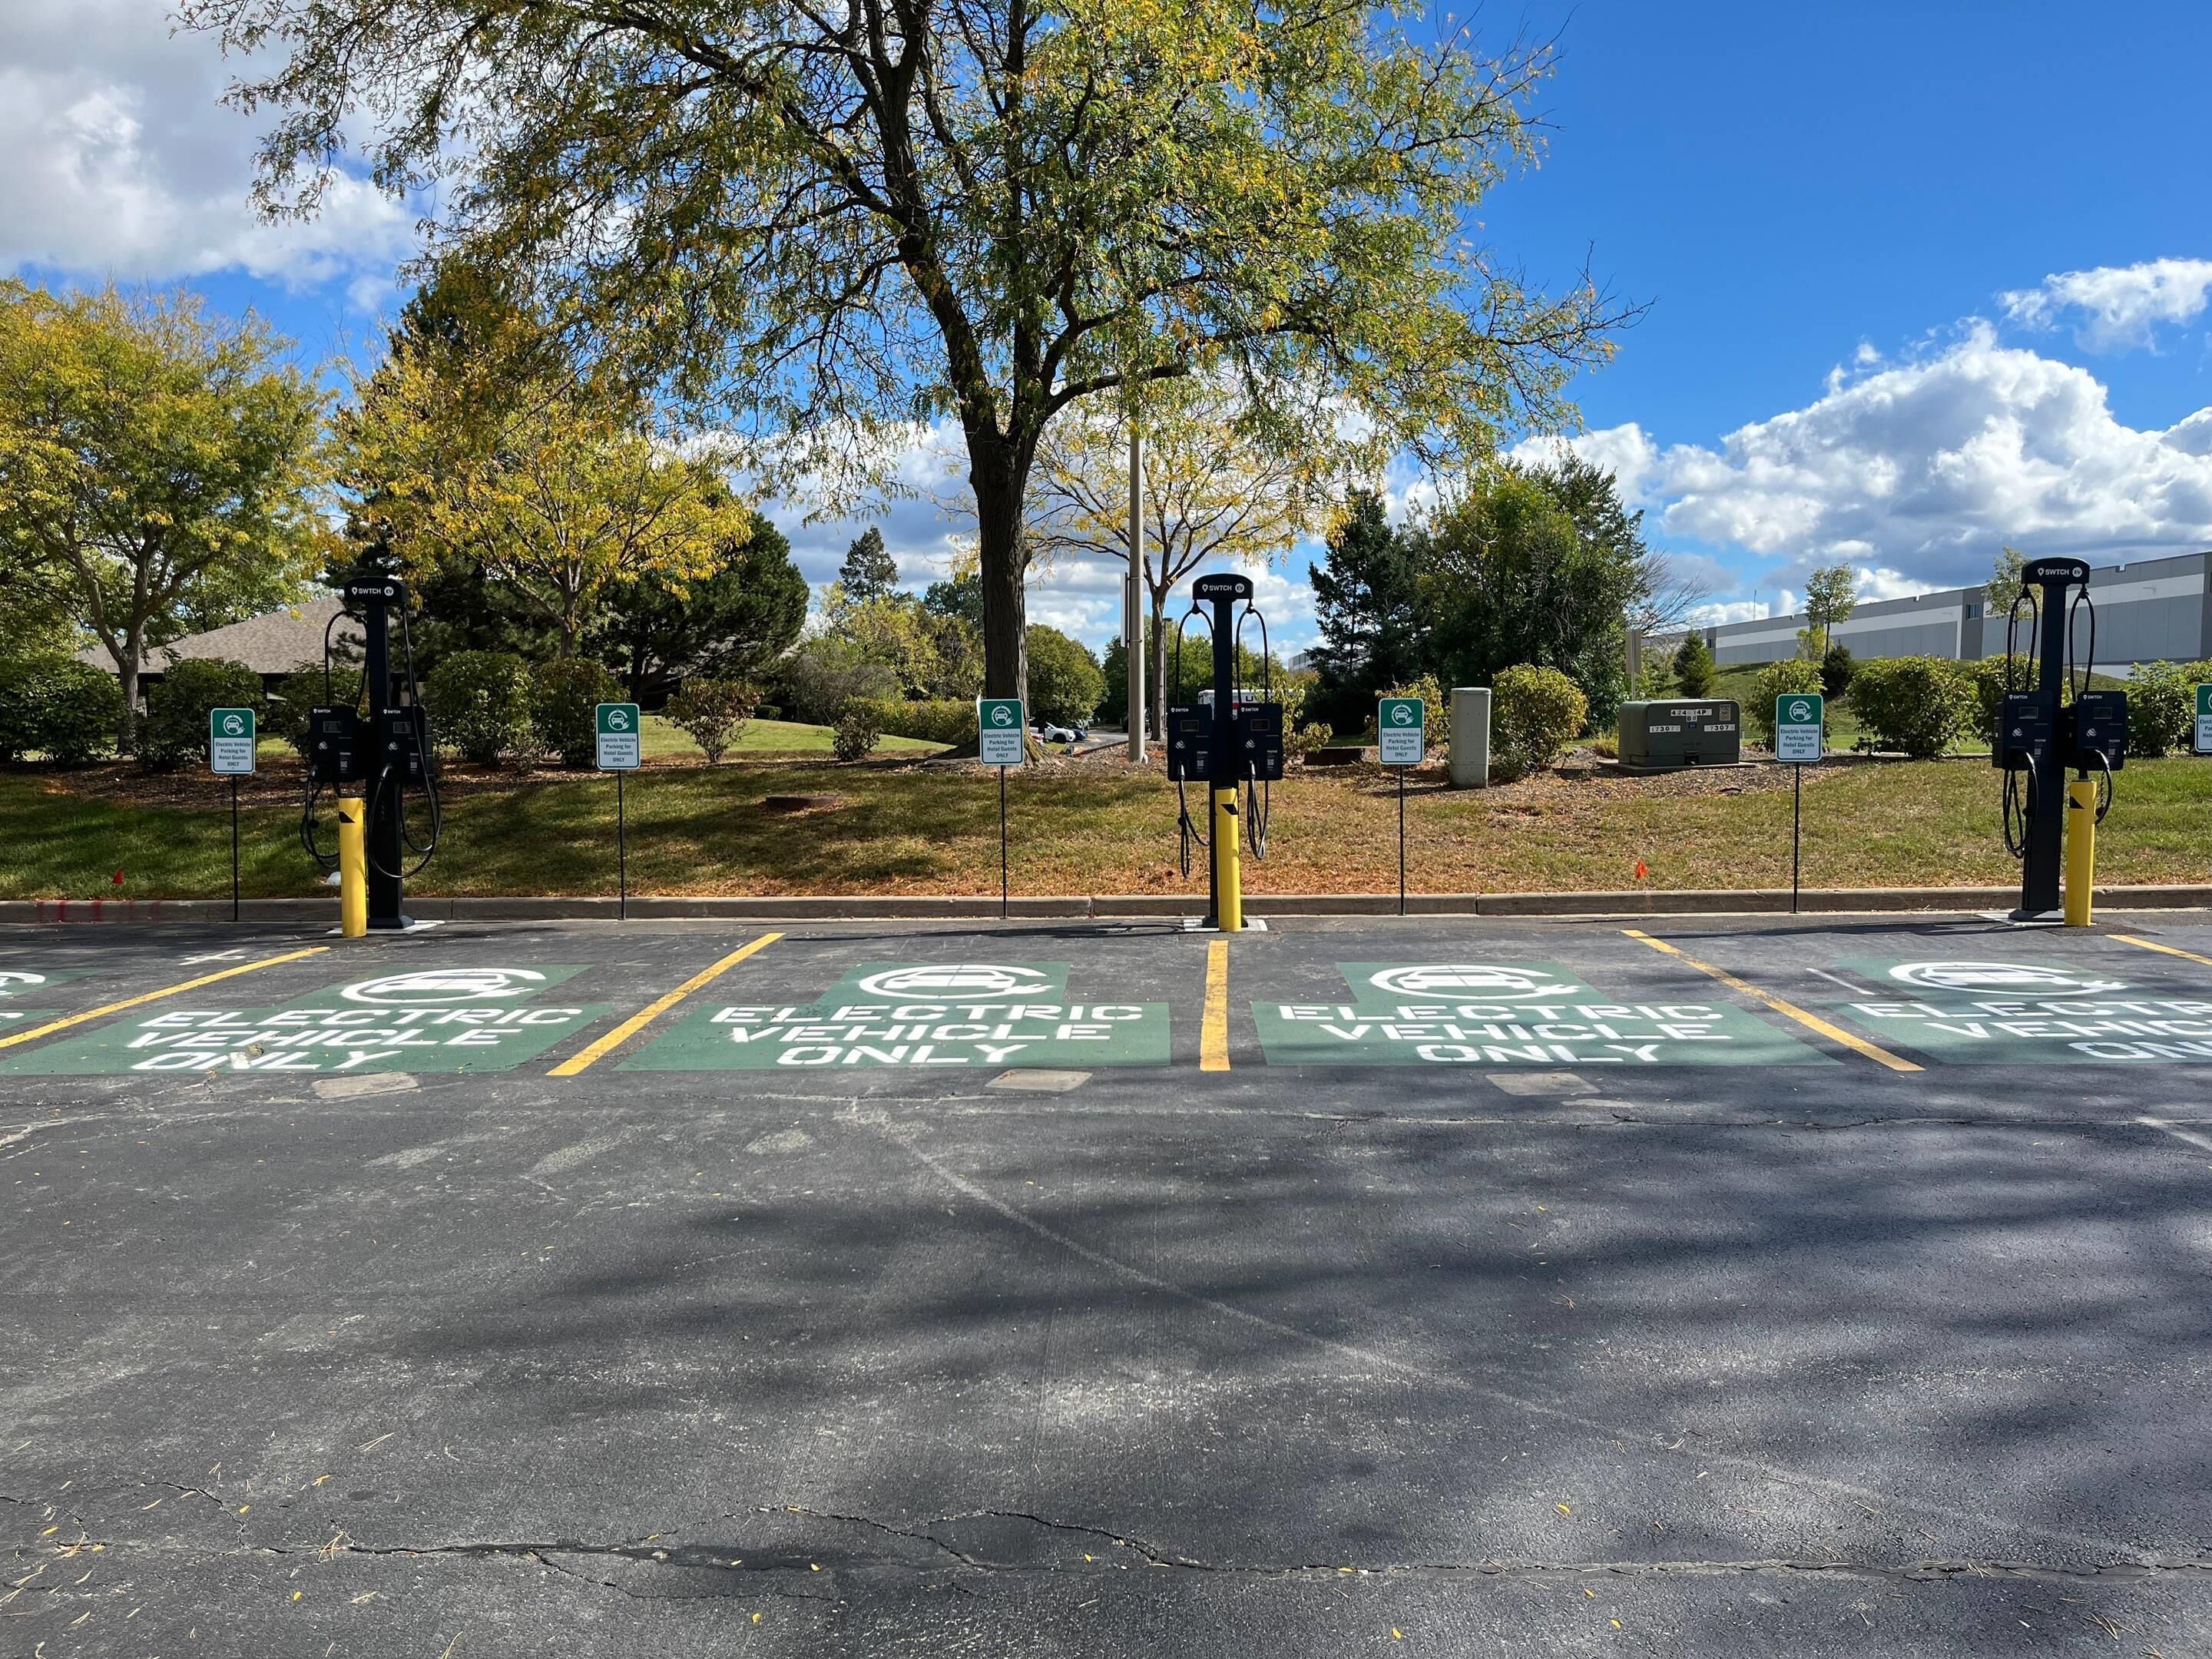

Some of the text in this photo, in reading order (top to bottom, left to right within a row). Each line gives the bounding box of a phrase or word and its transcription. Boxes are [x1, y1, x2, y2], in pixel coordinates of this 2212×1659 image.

[137, 1008, 584, 1028] ELECTRIC
[709, 1005, 1143, 1024] ELECTRIC
[1278, 1004, 1725, 1022] ELECTRIC
[729, 1023, 1113, 1043] VEHICLE
[1319, 1023, 1734, 1041] VEHICLE
[1922, 1019, 2212, 1038] VEHIC
[126, 1028, 523, 1049] VEHICLE
[776, 1044, 1028, 1066] ONLY
[1414, 1044, 1661, 1063] ONLY
[2068, 1041, 2212, 1059] ON
[130, 1050, 404, 1071] ONLY
